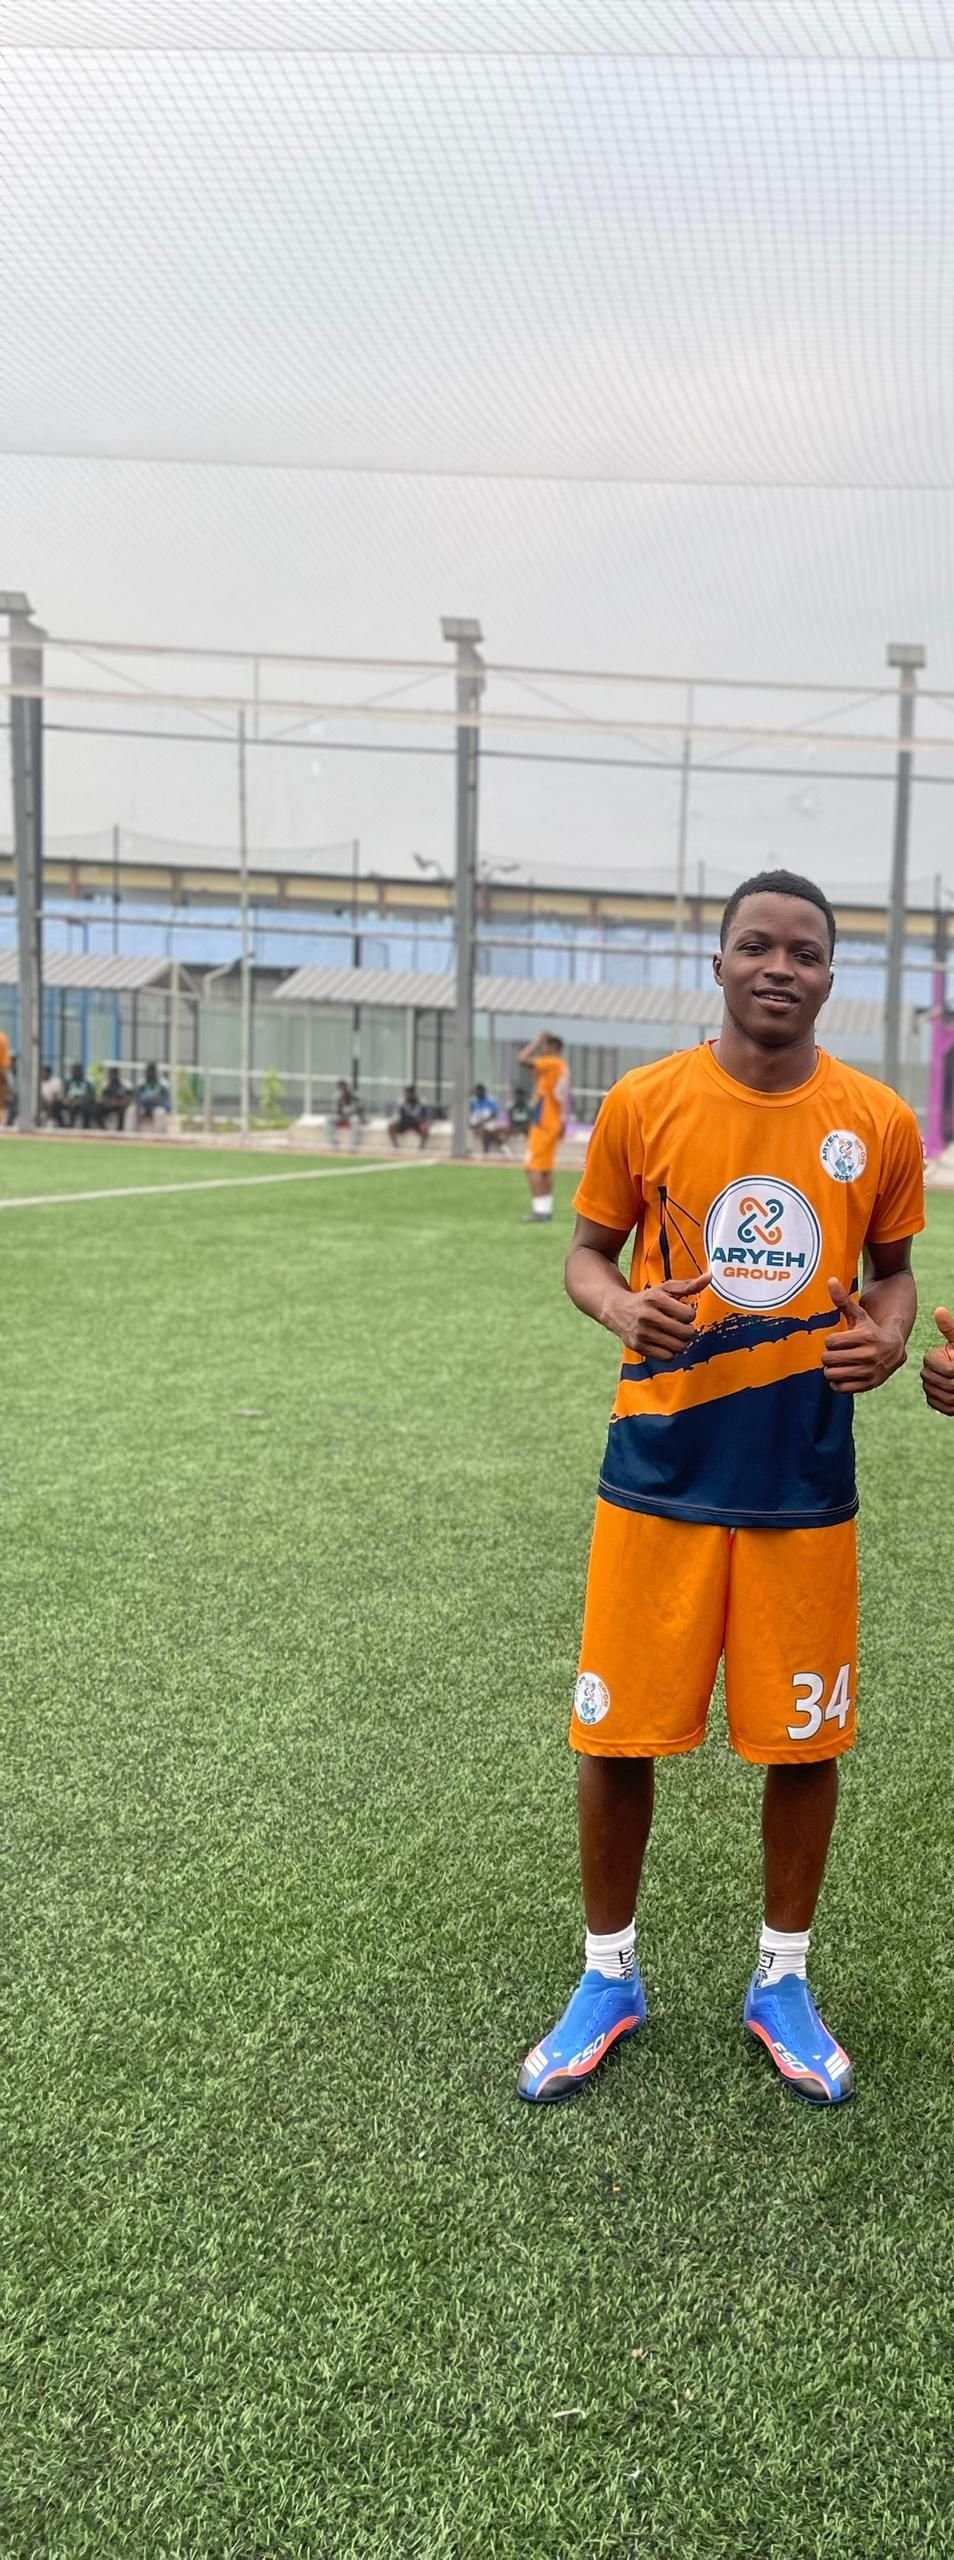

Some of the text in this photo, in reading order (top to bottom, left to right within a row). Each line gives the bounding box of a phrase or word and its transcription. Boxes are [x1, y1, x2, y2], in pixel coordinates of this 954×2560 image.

[711, 1247, 806, 1268] ARYEH
[723, 1266, 791, 1282] GROUP
[786, 1663, 850, 1740] 34
